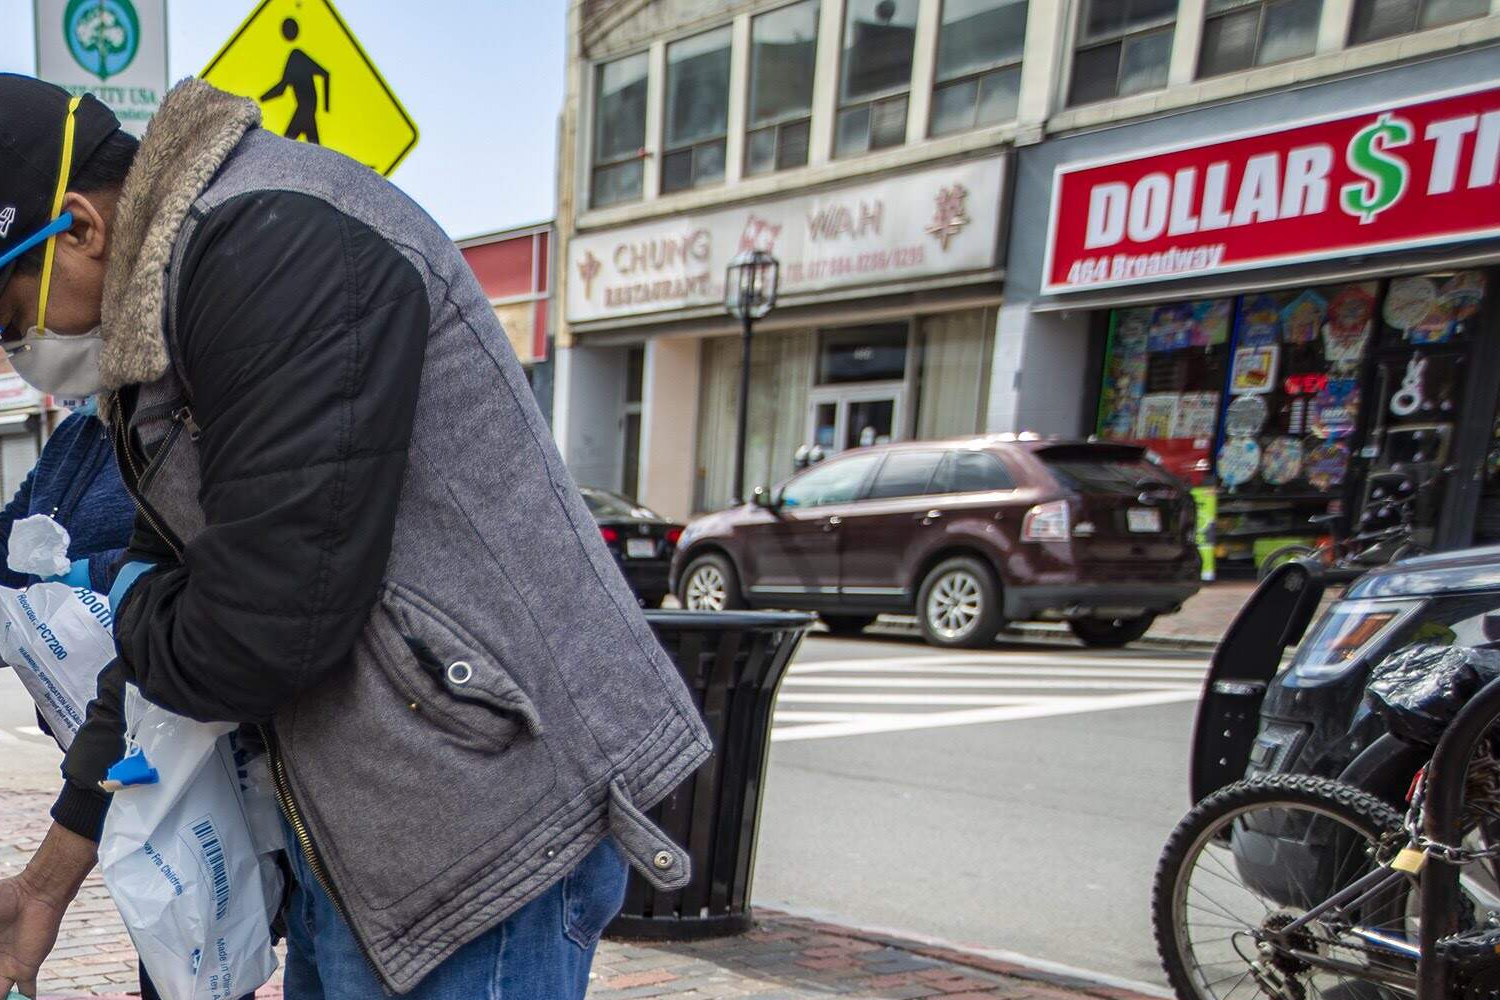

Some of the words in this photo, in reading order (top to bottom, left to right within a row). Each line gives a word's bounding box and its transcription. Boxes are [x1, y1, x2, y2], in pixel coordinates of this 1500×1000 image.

[1084, 143, 1334, 250] DOLLAR
[613, 228, 711, 275] CHUNG
[807, 199, 884, 242] WAH
[1066, 256, 1109, 285] 464
[1112, 243, 1225, 281] Broadway
[604, 273, 711, 307] RESTAURANT
[36, 623, 68, 661] PC7200
[216, 937, 228, 962] Made
[220, 963, 229, 972] in
